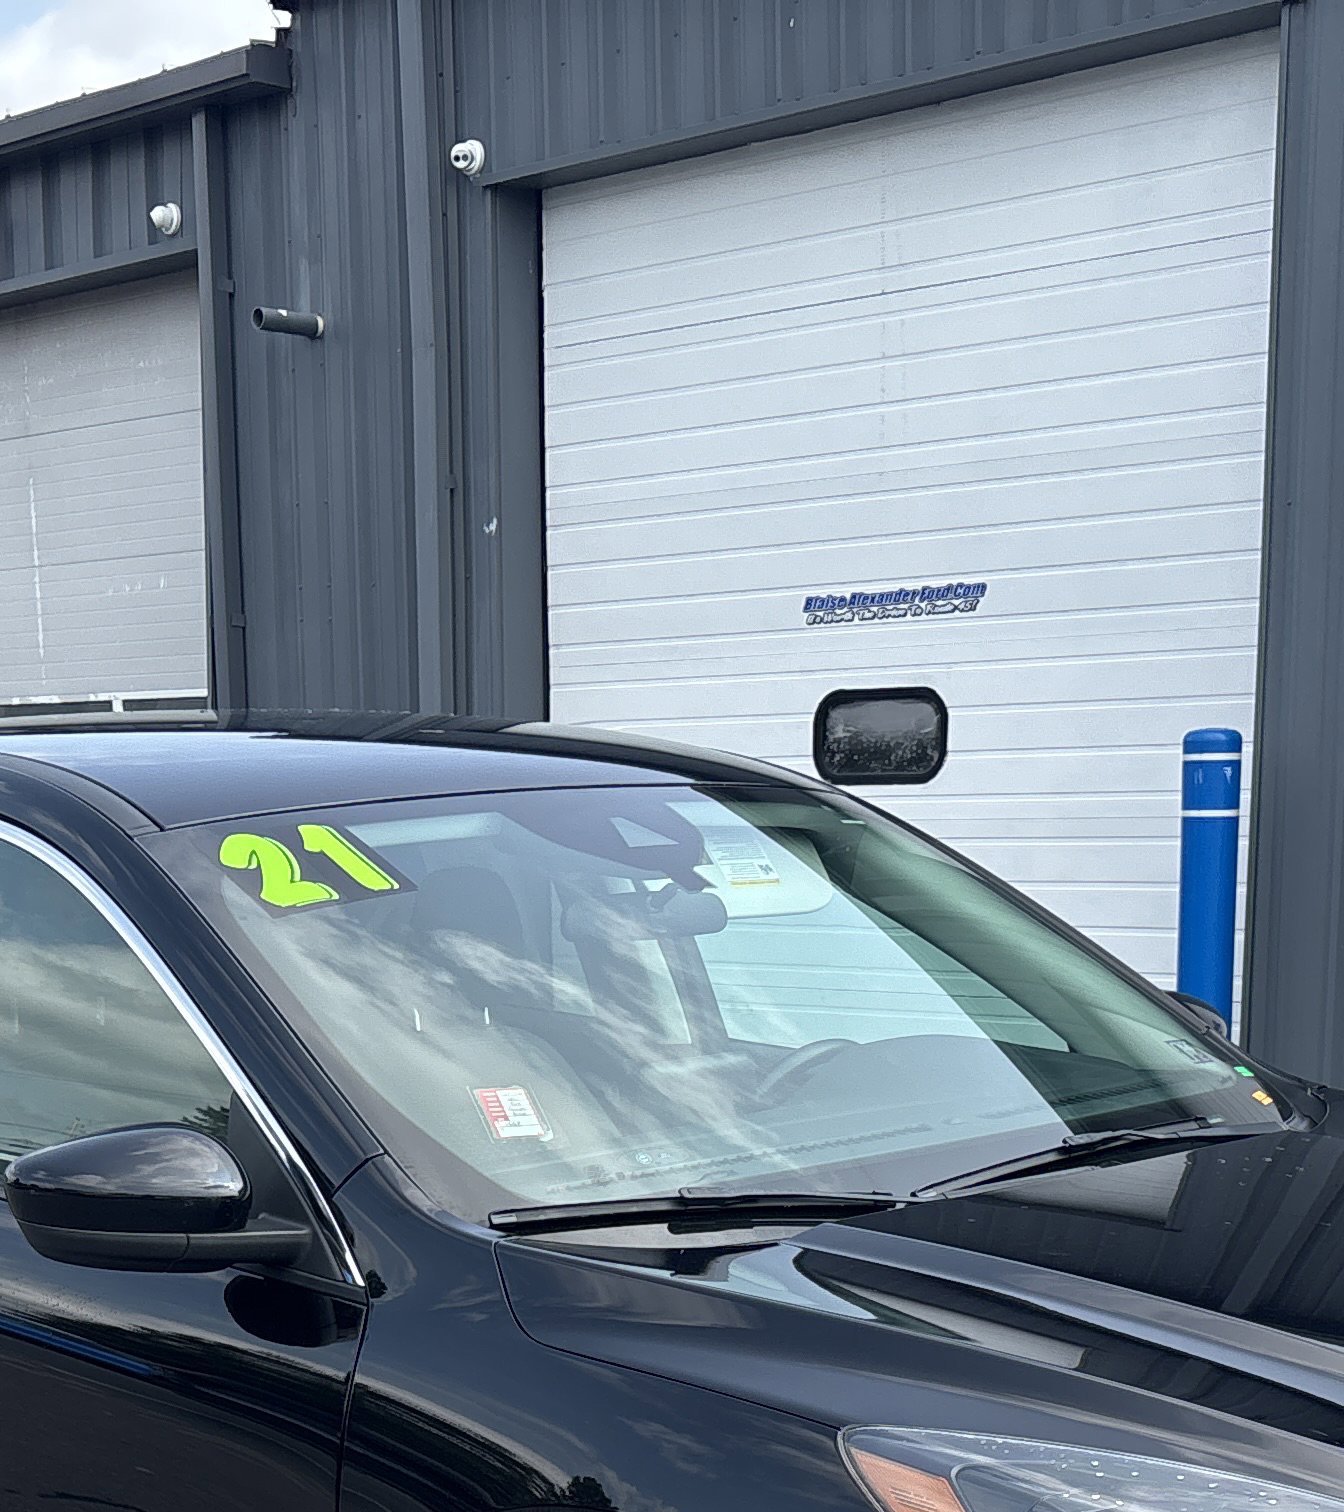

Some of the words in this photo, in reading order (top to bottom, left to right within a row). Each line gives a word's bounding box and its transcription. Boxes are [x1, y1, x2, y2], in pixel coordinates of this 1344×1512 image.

[803, 594, 847, 613] Blaise
[847, 587, 919, 609] Alexander
[219, 823, 400, 908] 21
